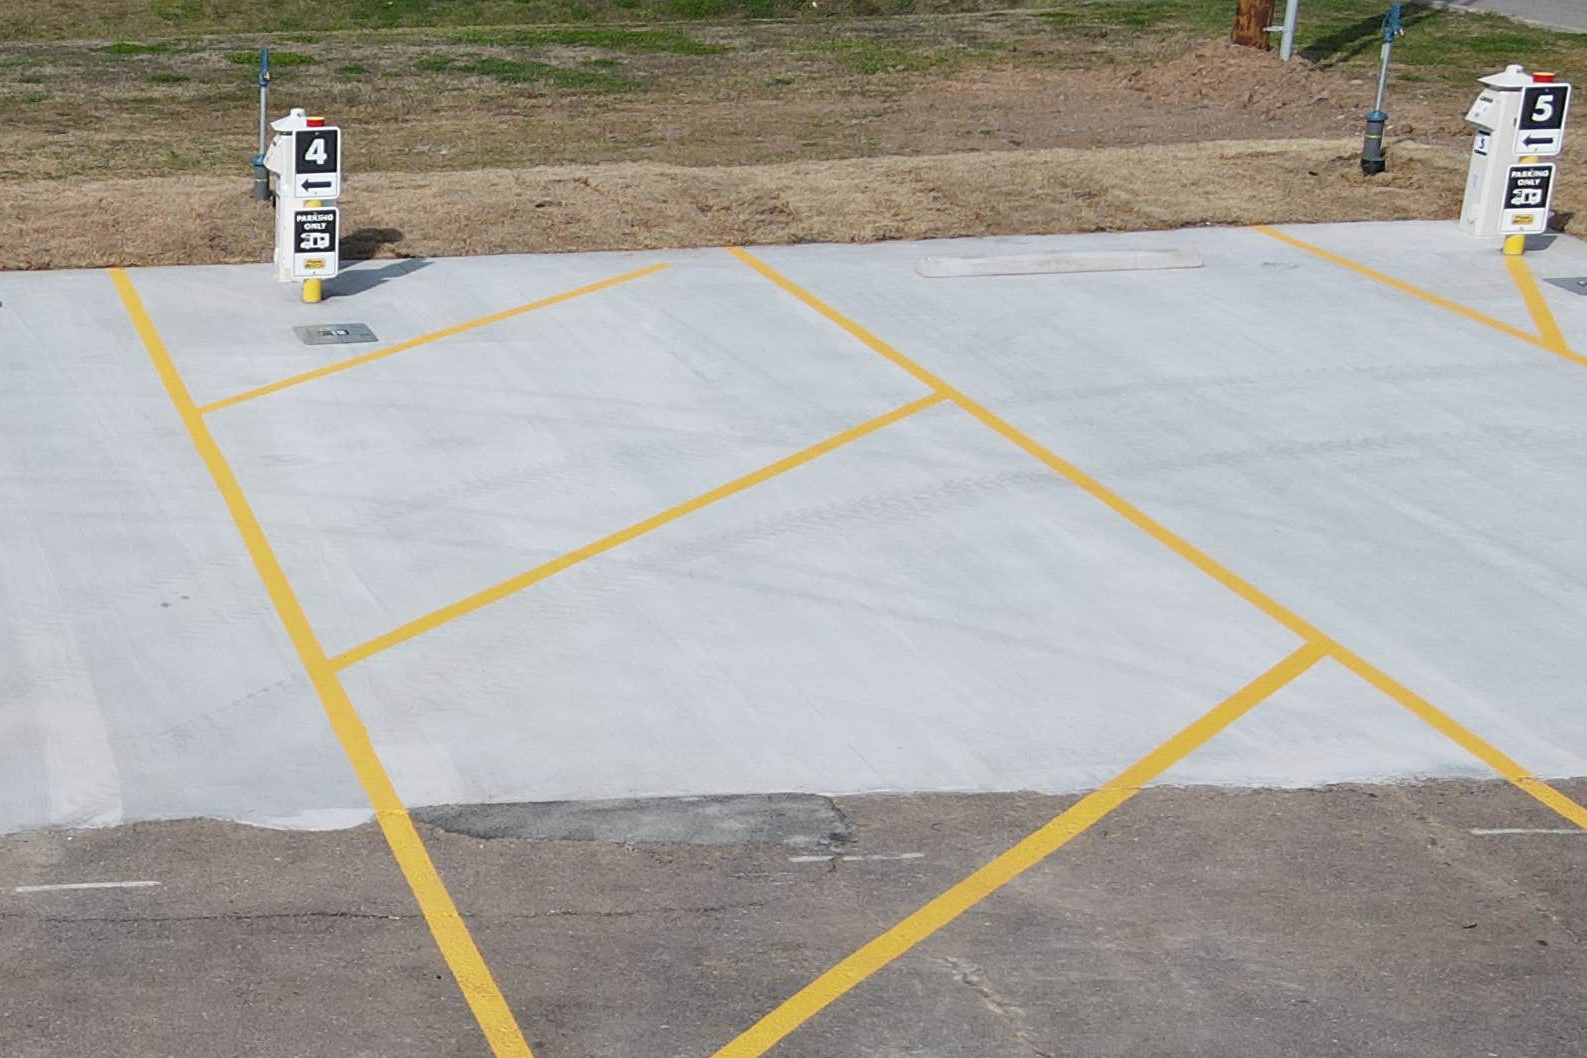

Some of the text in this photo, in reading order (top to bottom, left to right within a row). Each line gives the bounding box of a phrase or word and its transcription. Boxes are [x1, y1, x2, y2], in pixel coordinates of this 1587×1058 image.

[1531, 94, 1554, 122] 5
[304, 138, 328, 165] 4
[1511, 169, 1549, 179] PARKING
[1517, 178, 1541, 187] ONLY
[296, 213, 334, 223] PARKING
[303, 222, 327, 231] ONLY
